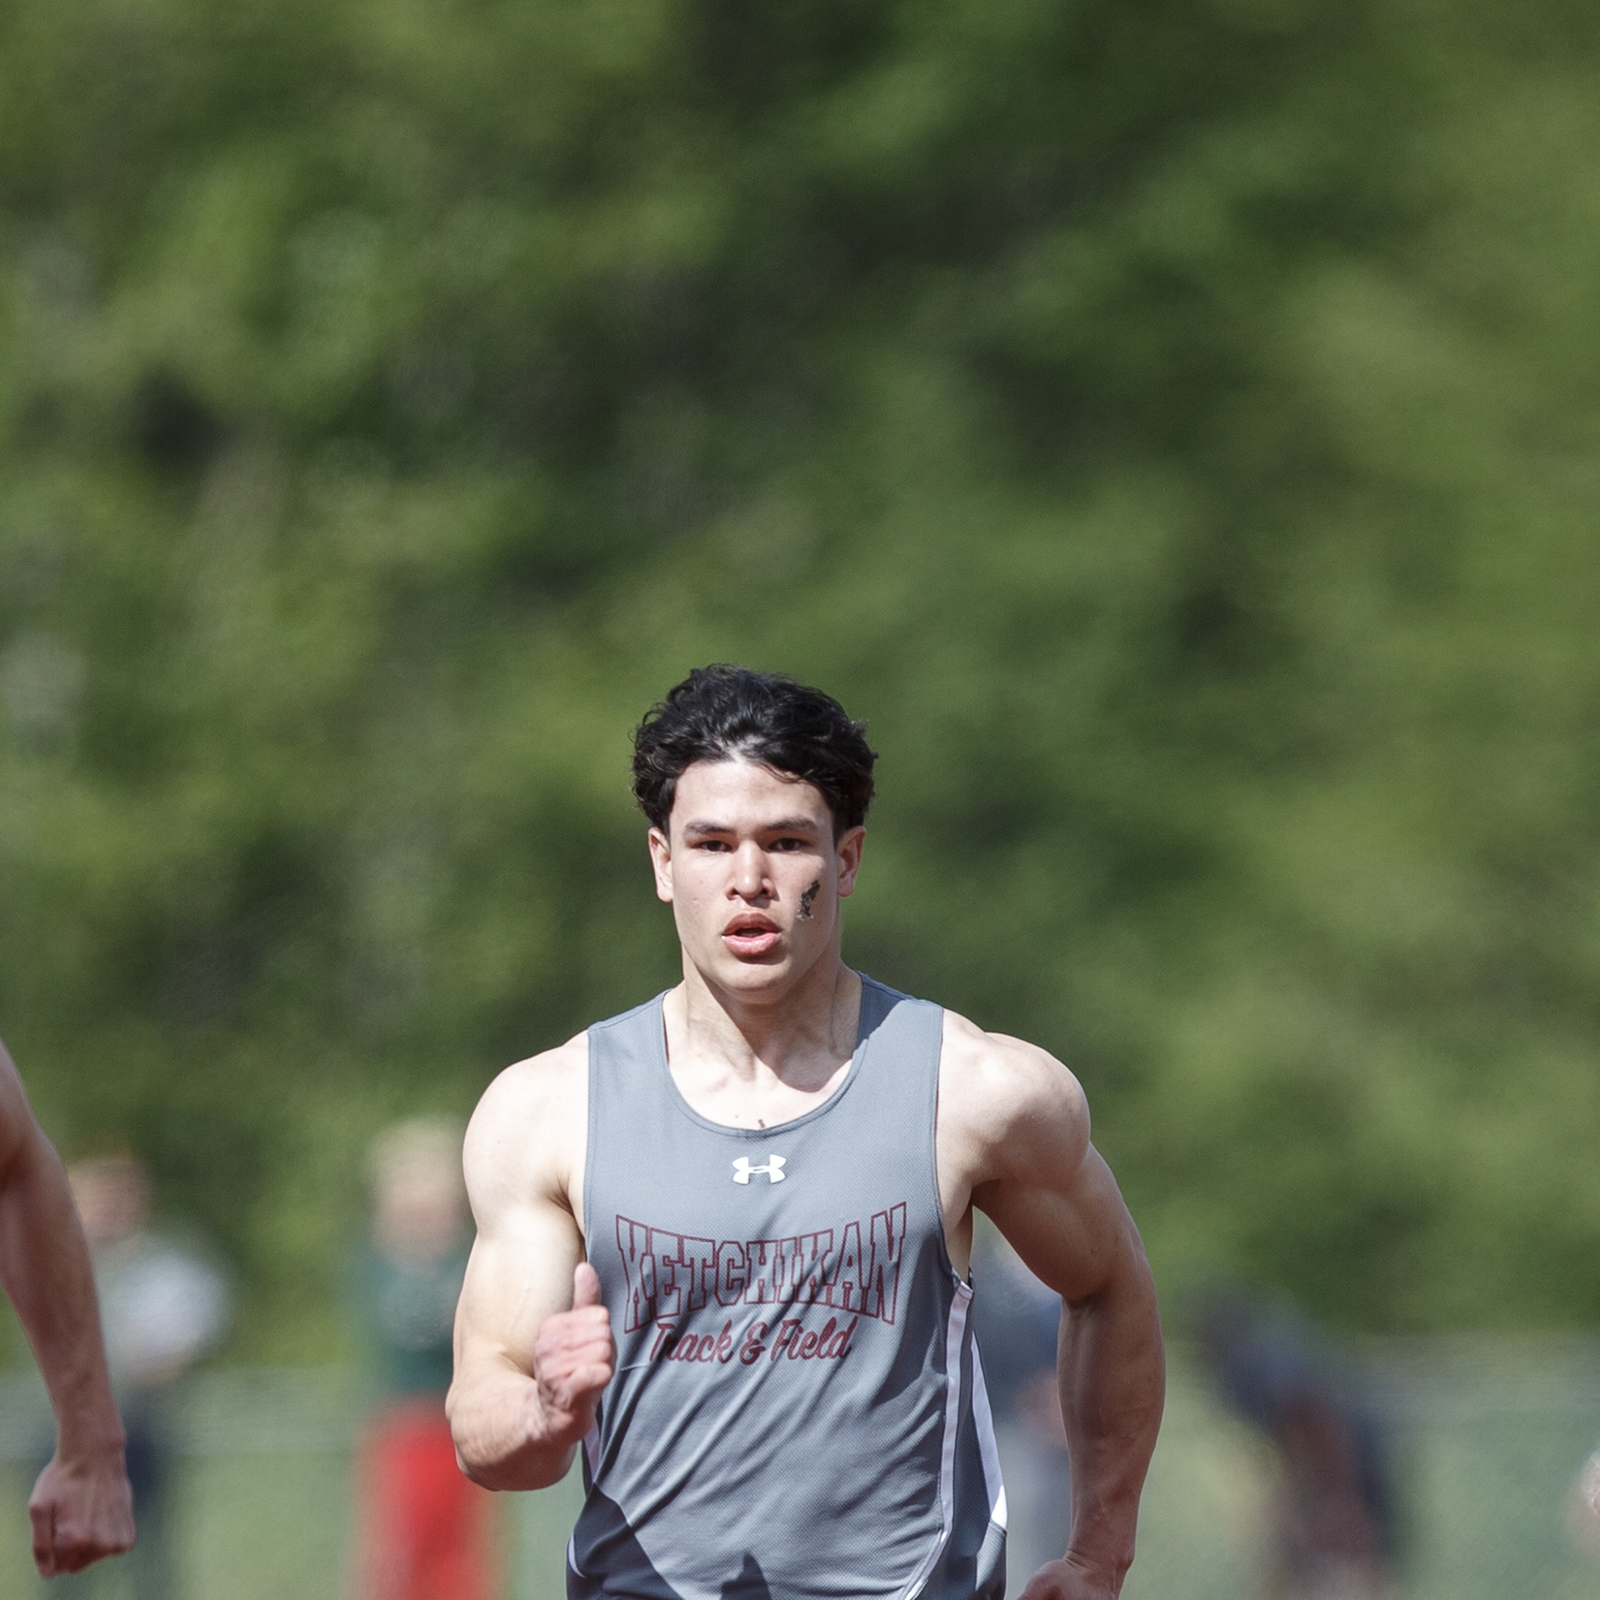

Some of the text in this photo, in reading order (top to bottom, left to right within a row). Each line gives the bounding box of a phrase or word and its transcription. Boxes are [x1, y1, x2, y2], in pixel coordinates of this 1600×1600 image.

[616, 1202, 907, 1334] KETCHIKAN
[649, 1315, 858, 1366] Track & Field
